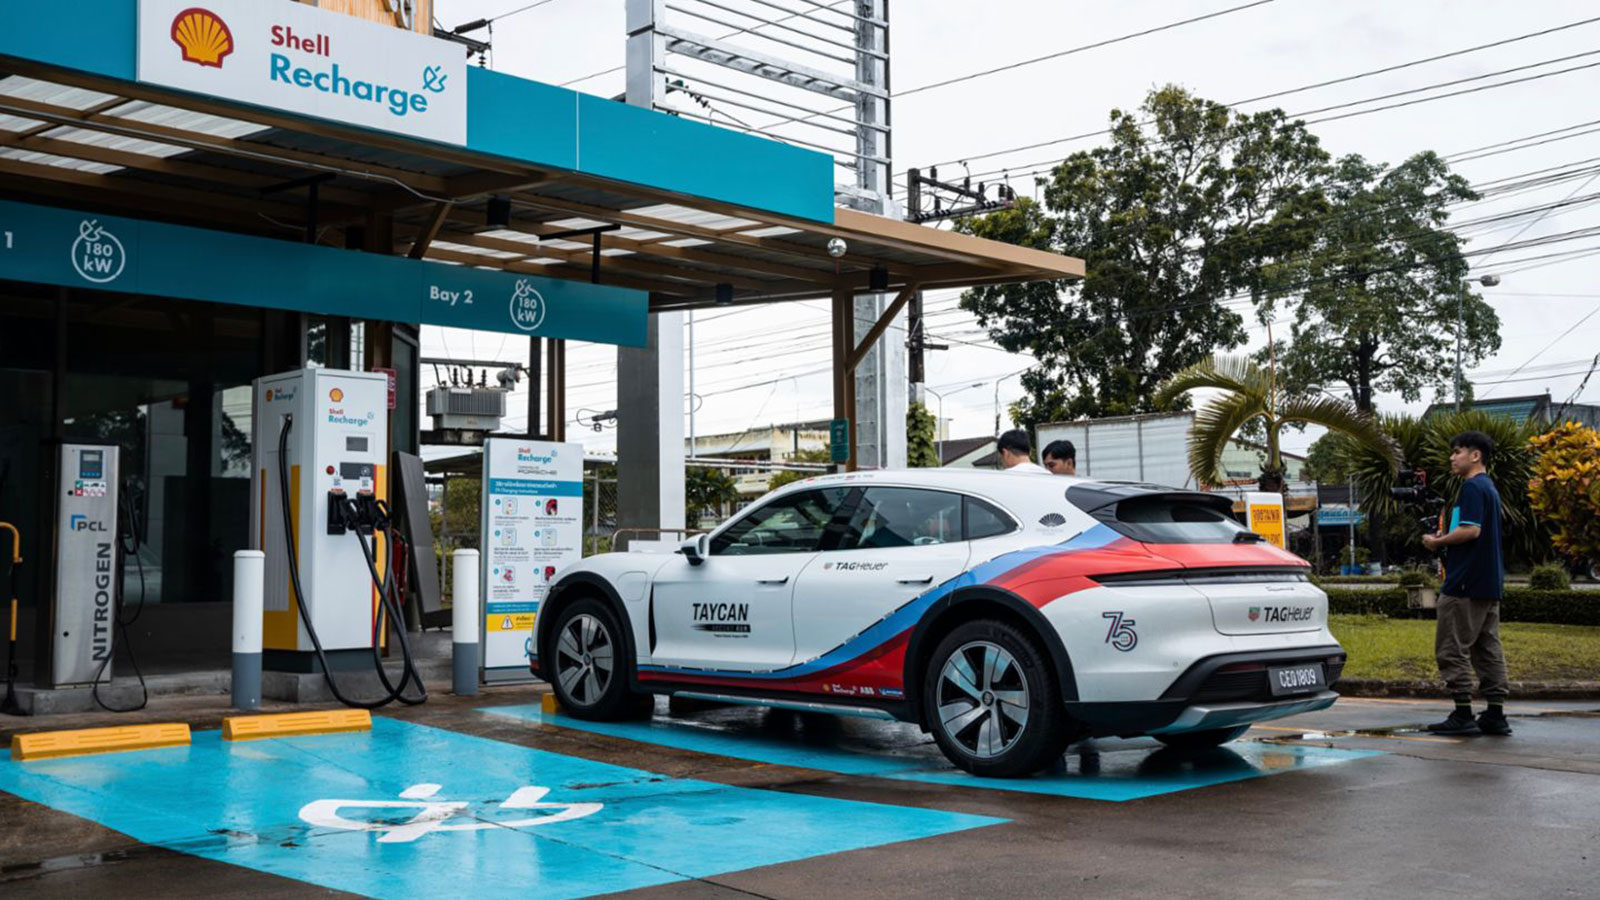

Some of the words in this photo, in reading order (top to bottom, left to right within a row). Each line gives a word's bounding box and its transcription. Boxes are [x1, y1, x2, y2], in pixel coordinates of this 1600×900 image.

[270, 25, 330, 57] Shell
[270, 52, 428, 116] Recharge
[4, 231, 13, 249] 1
[85, 241, 113, 257] 180
[83, 254, 113, 274] kW
[429, 285, 460, 306] Bay
[463, 290, 474, 304] 2
[518, 297, 538, 310] 180
[517, 307, 538, 323] kW
[328, 415, 368, 426] Recharge
[517, 453, 553, 464] Recharge
[76, 521, 108, 532] PCL
[92, 543, 111, 661] NITROGEN
[692, 603, 749, 621] TAYCAN
[1102, 611, 1138, 652] 75
